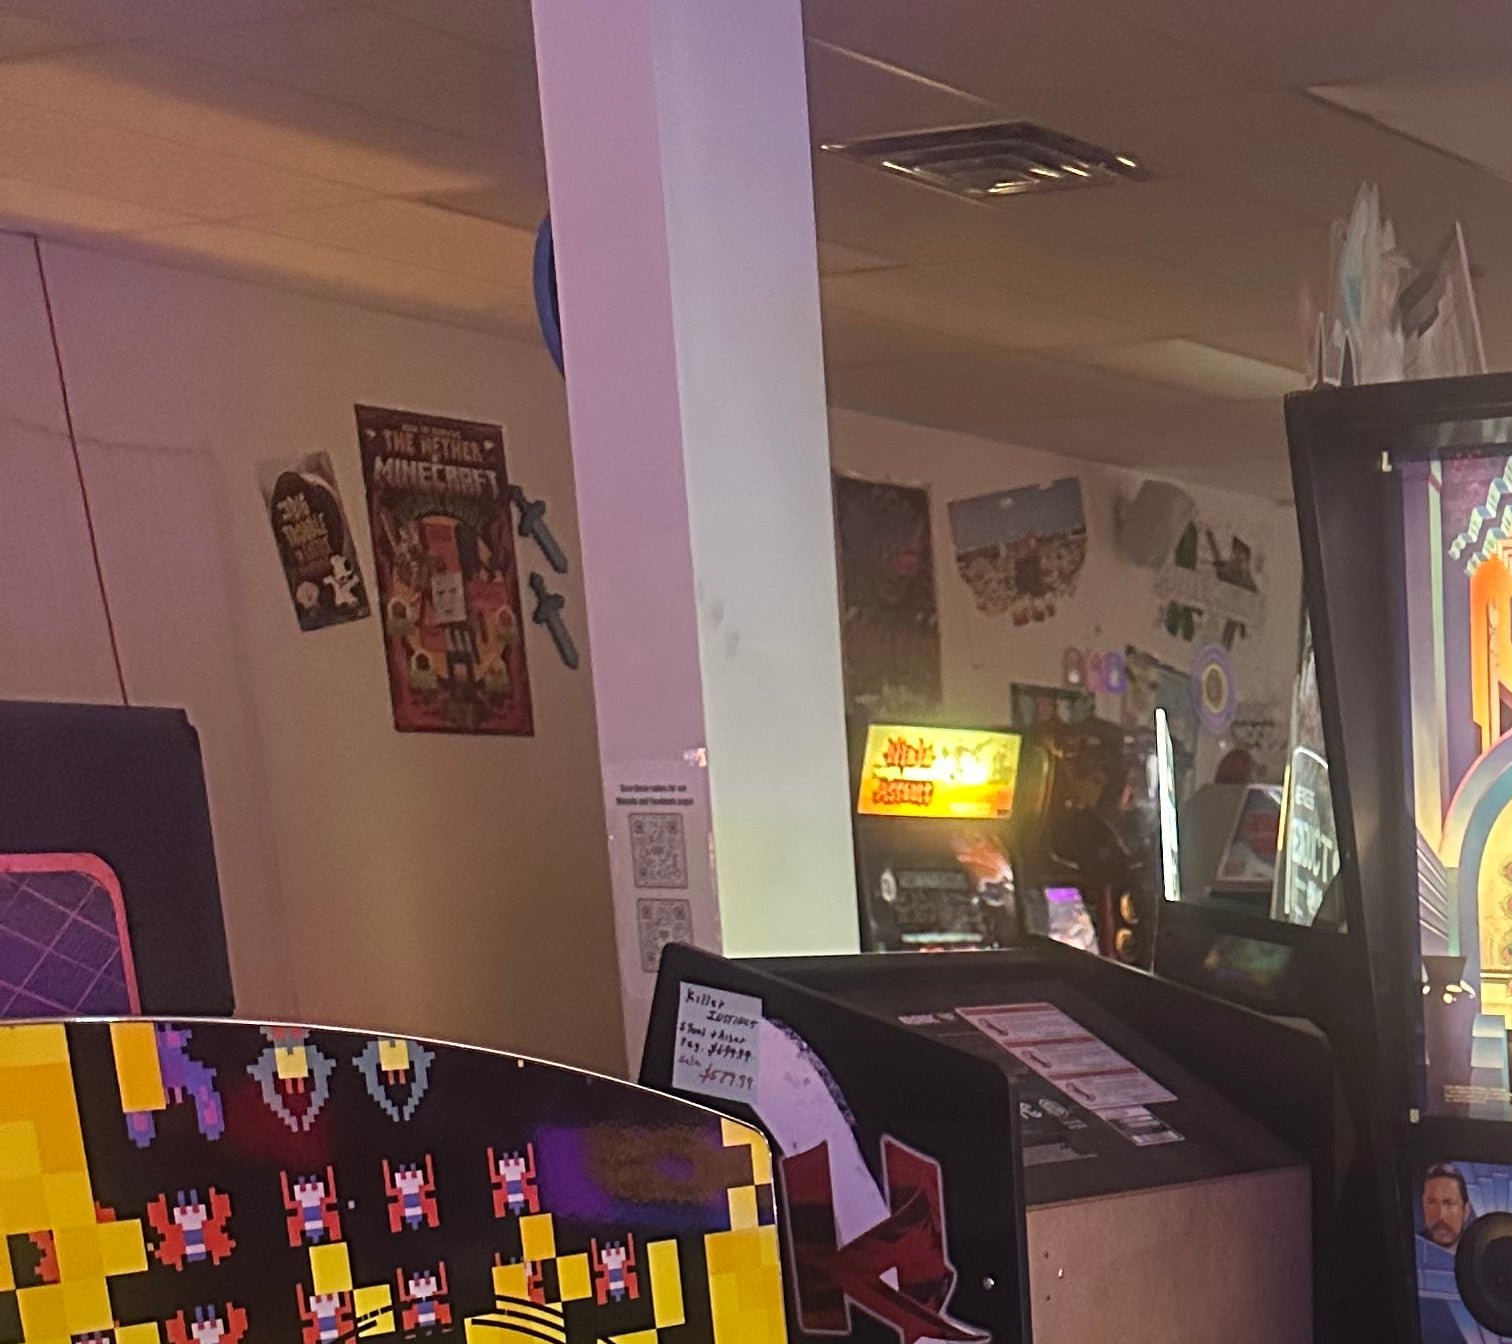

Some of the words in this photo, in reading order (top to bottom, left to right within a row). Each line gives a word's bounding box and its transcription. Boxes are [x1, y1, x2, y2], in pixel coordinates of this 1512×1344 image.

[383, 429, 415, 454] THE
[374, 456, 499, 496] MINECRAFT
[686, 988, 725, 1009] Killer
